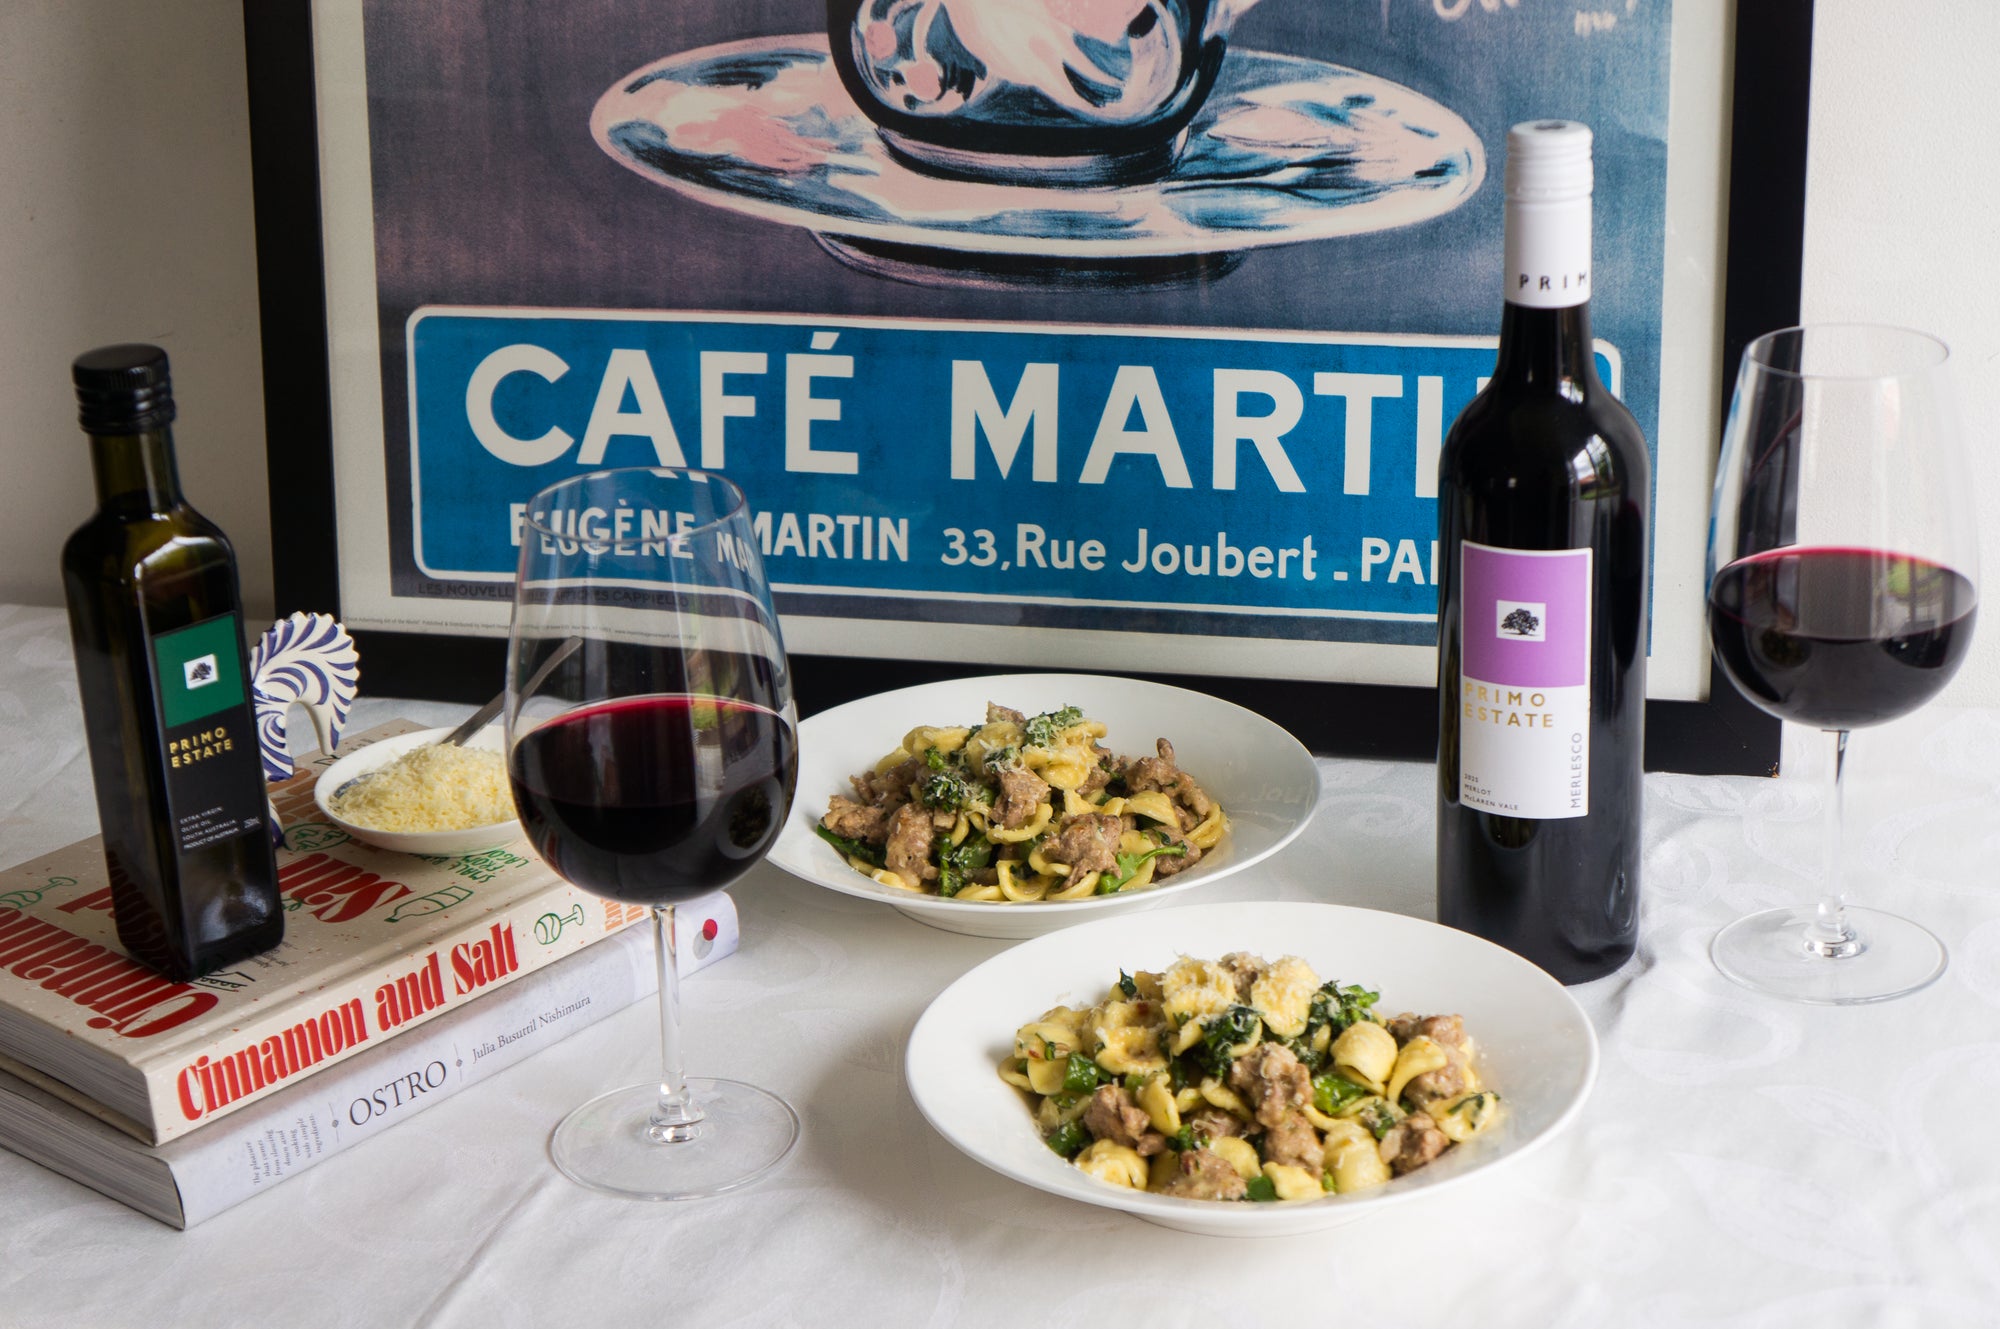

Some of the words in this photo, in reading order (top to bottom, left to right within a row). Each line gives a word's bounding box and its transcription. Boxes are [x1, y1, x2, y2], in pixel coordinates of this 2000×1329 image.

[465, 331, 859, 475] CAFÉ
[950, 359, 1493, 498] MARTI
[1121, 528, 1318, 583] Joubert
[418, 583, 442, 596] LES
[1463, 682, 1546, 708] PRIMO
[1463, 702, 1554, 728] ESTATE
[169, 727, 226, 755] PRIMO
[171, 738, 234, 769] ESTATE
[1570, 732, 1583, 809] MERLESCO
[1464, 783, 1492, 797] MERLOT
[180, 814, 200, 824] EXTRA
[201, 806, 223, 817] VIRGIN
[1498, 802, 1520, 811] VALE
[181, 823, 199, 833] OLIVE
[182, 830, 203, 841] SOUTH
[204, 819, 236, 834] AUSTRALIA
[177, 997, 369, 1121] Cinnamon
[374, 951, 446, 1033] and
[450, 919, 520, 997] Salt
[349, 1060, 447, 1126] OSTRO
[471, 1042, 497, 1065] Julia
[496, 1019, 538, 1049] Busuttil
[539, 995, 592, 1029] Nishimura
